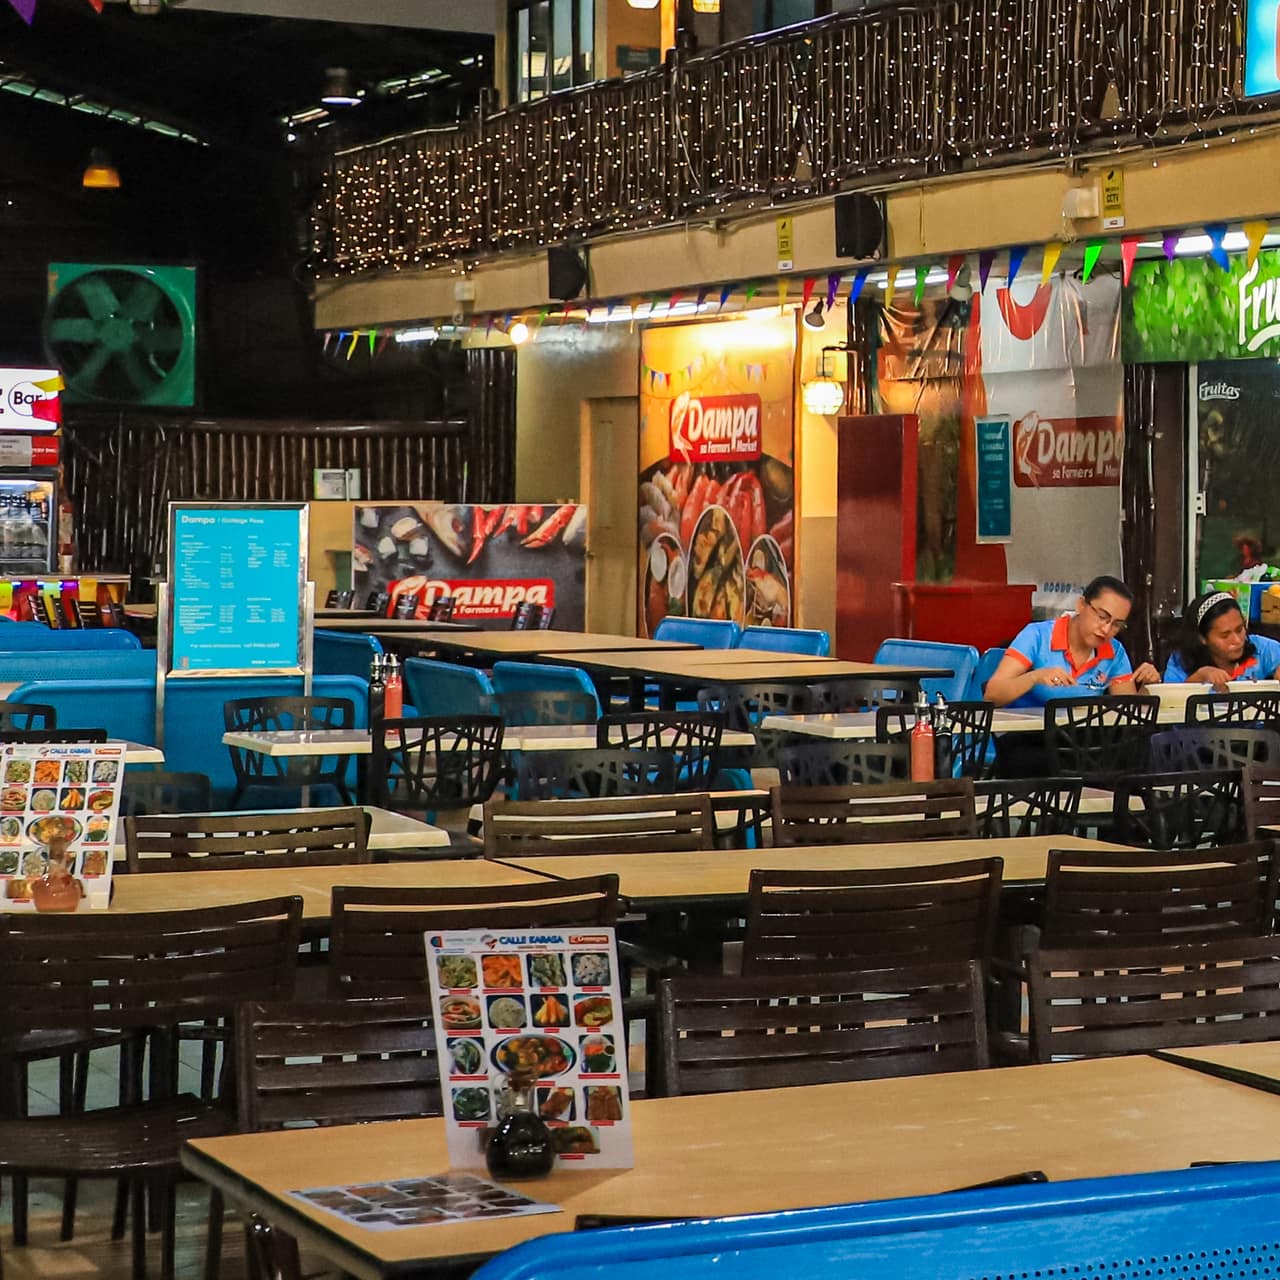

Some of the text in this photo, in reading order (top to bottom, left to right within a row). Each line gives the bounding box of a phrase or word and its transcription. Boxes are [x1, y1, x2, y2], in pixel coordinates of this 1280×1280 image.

[13, 391, 43, 405] Bar
[1199, 381, 1241, 401] Fruitas
[687, 399, 759, 451] Dampa
[424, 580, 548, 611] Dampa
[499, 936, 528, 945] CALLE
